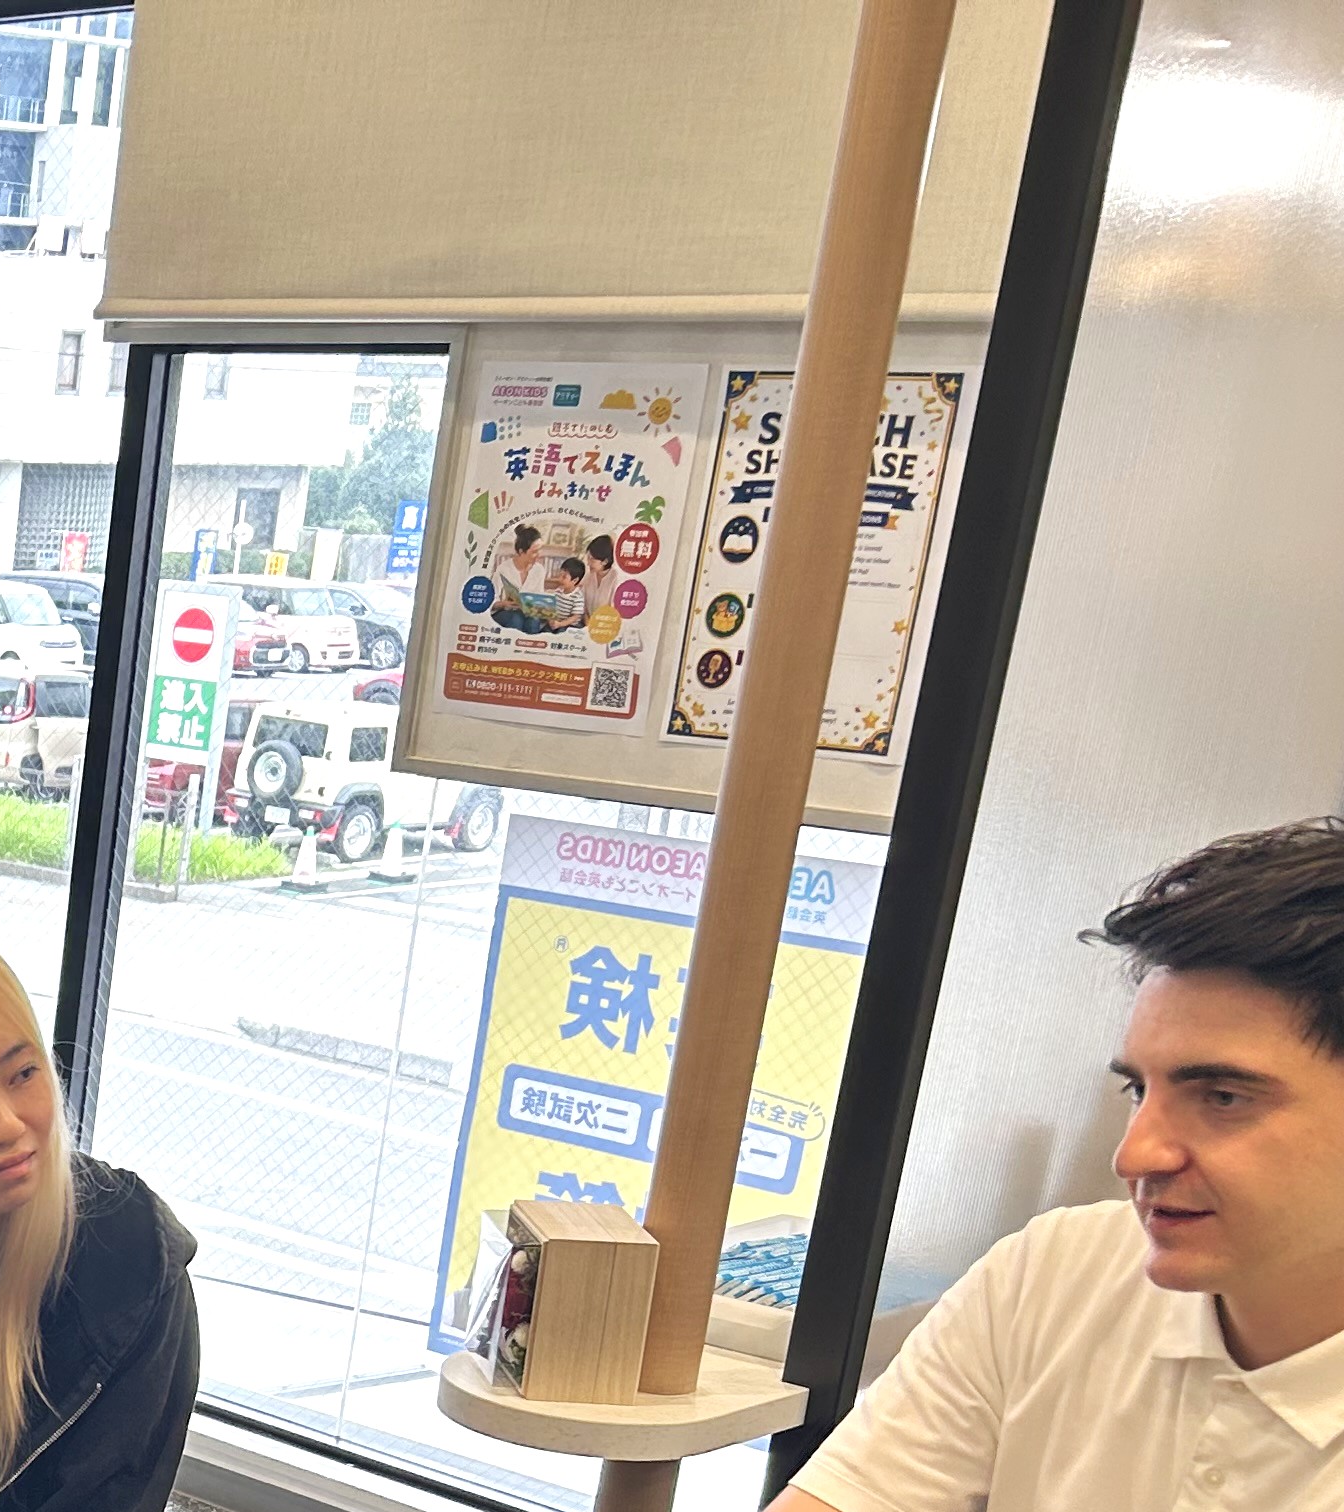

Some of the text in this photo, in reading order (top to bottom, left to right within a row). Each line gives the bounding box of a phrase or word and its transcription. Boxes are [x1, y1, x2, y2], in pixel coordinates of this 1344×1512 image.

[552, 421, 615, 434] 親子でたのしむ
[503, 443, 650, 488] 英語でえほん
[534, 480, 612, 502] よみきかせ
[619, 539, 653, 560] 無料
[160, 679, 208, 714] 進入
[156, 713, 205, 747] 禁止
